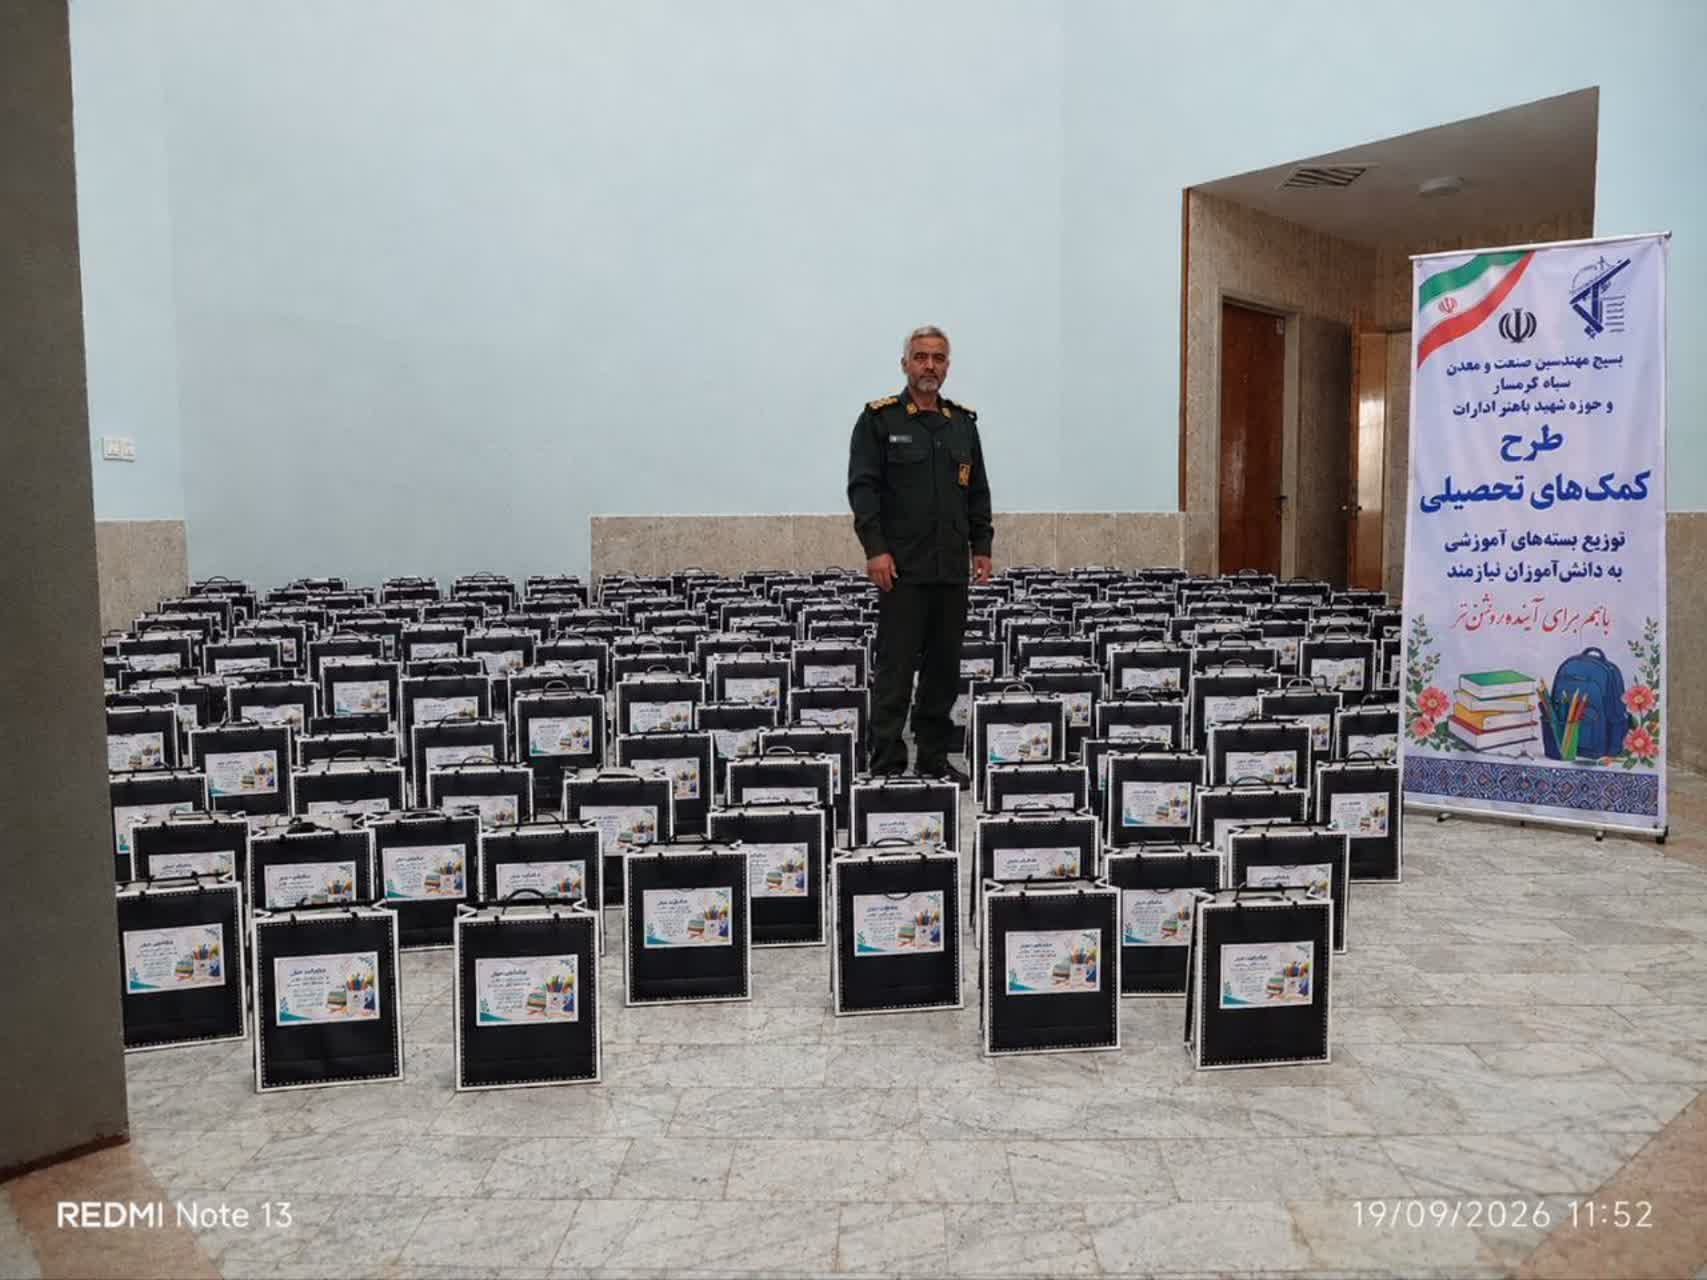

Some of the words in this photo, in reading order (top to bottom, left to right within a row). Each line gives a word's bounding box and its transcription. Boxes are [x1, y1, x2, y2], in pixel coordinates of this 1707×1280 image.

[1446, 361, 1480, 376] معدن
[1484, 363, 1491, 373] و
[1494, 357, 1531, 370] صنعت
[1535, 355, 1589, 371] مهندسین
[1593, 354, 1623, 370] بسیج
[1452, 399, 1496, 418] ادارات
[1500, 399, 1530, 417] باهنر
[1534, 398, 1566, 414] شهید
[1569, 399, 1602, 415] حوزه
[1606, 403, 1613, 413] و
[1500, 424, 1563, 461] طرح
[1420, 475, 1524, 513] تحصیلی
[1444, 529, 1507, 552] آموزشی
[1582, 531, 1625, 552] توزیع
[1447, 562, 1500, 583] نیازمند
[1607, 564, 1622, 582] به
[1542, 607, 1579, 633] برای
